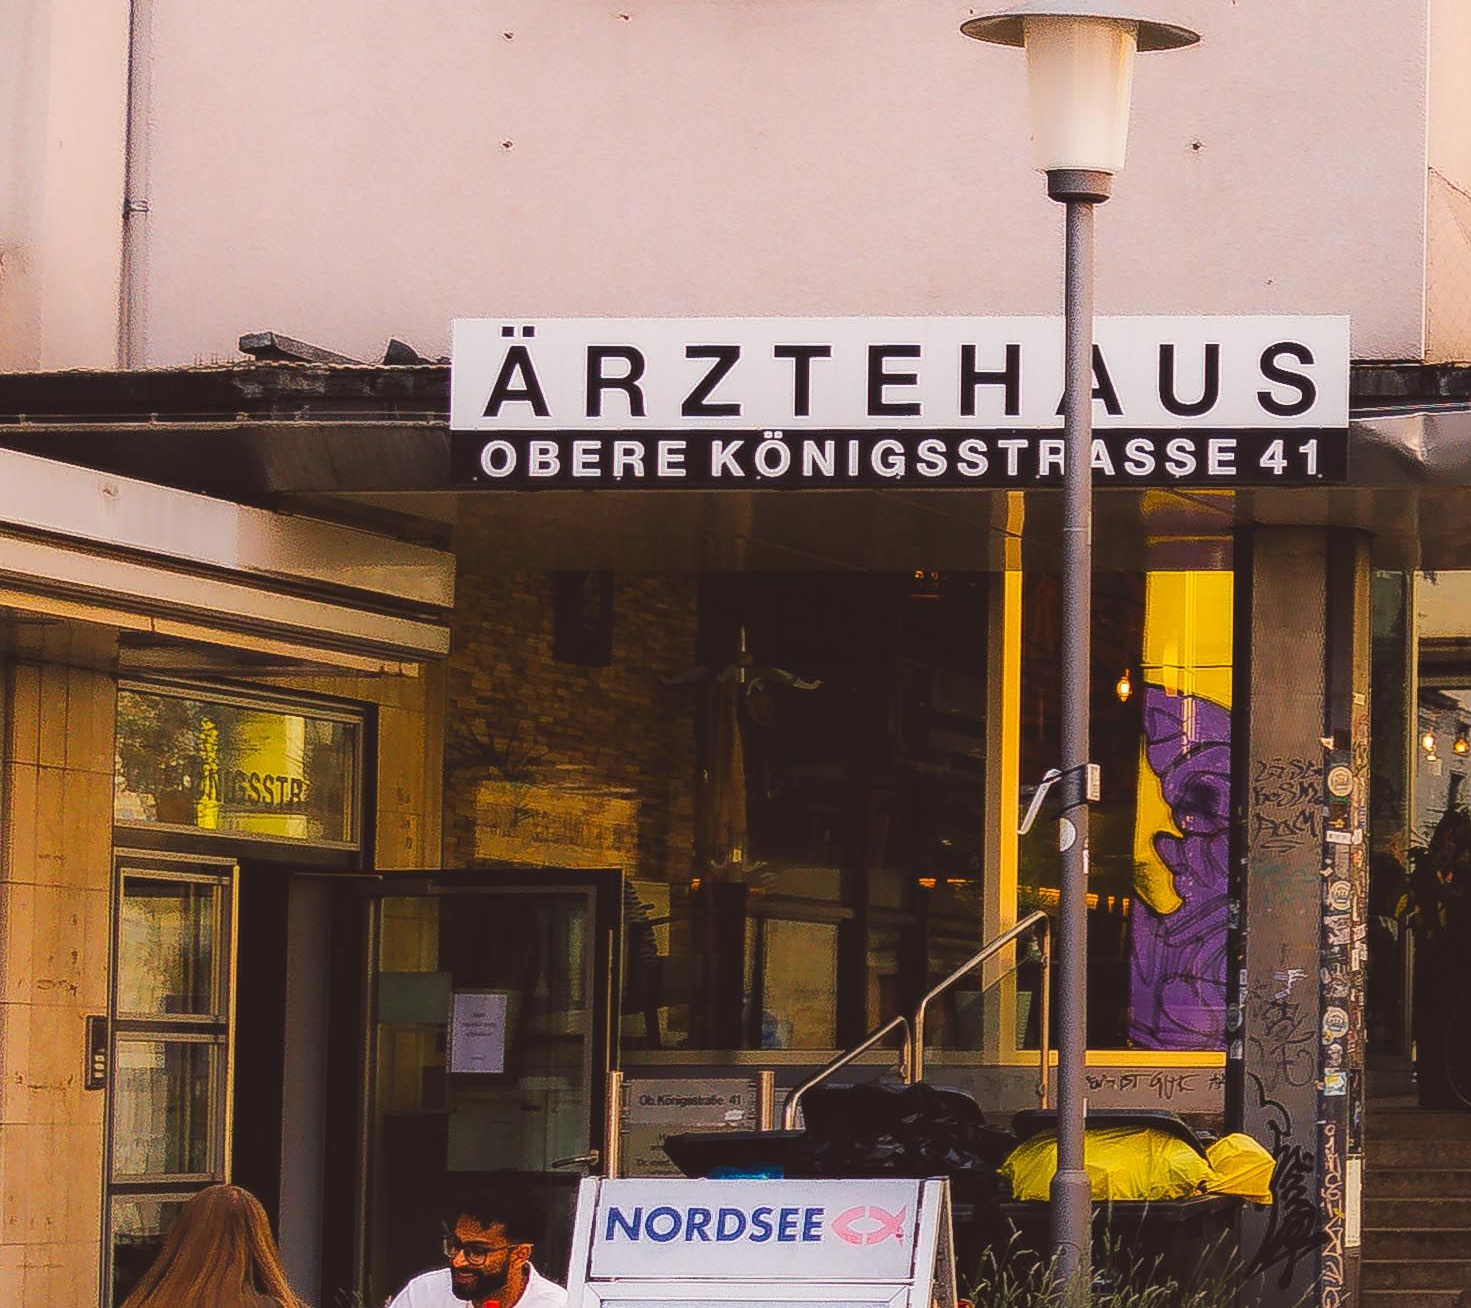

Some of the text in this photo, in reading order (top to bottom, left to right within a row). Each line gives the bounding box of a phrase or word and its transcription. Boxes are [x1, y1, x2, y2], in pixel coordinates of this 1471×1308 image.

[482, 430, 1322, 478] OBERE KÖNIGSSTRASSE 41
[729, 1095, 742, 1105] 41
[605, 1206, 826, 1243] NORDSEE
